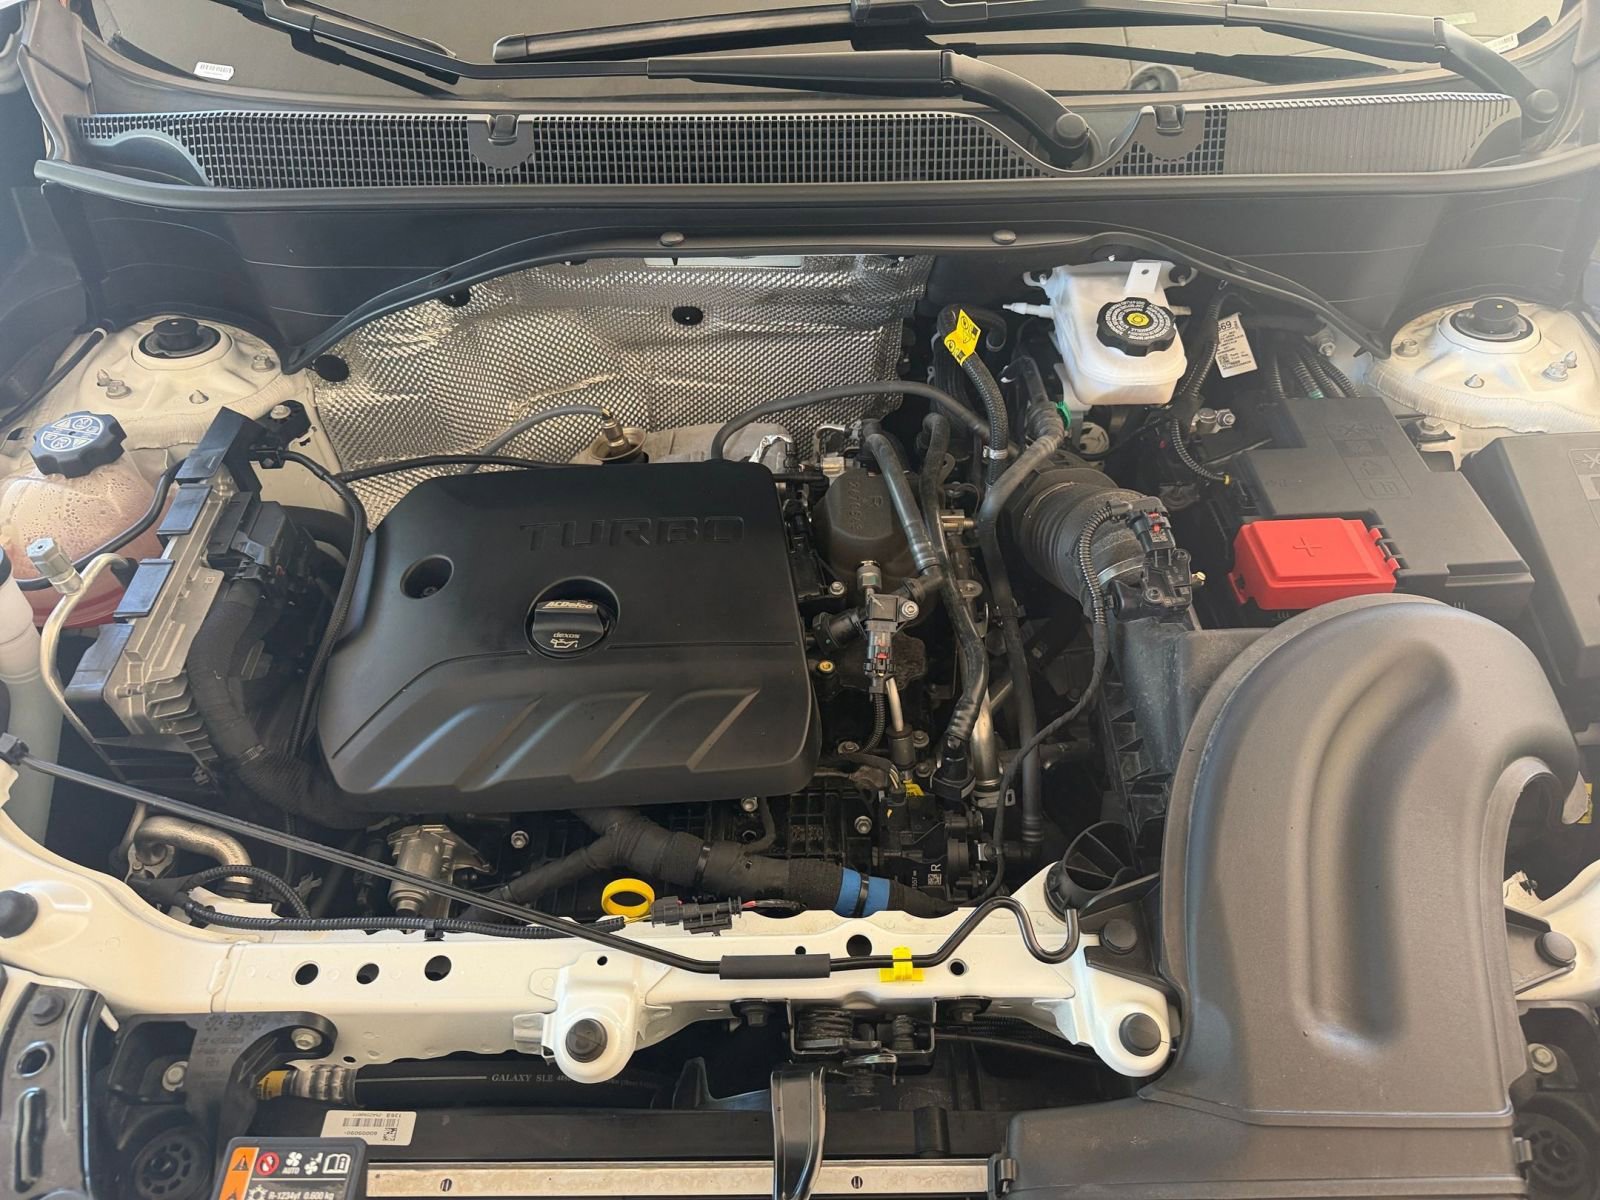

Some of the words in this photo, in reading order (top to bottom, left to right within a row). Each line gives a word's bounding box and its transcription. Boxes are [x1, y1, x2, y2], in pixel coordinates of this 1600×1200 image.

[519, 516, 745, 550] TURBO
[542, 601, 594, 609] ACDelco
[930, 863, 942, 872] R
[491, 1074, 532, 1082] GALAXY
[282, 1167, 301, 1175] AUTO
